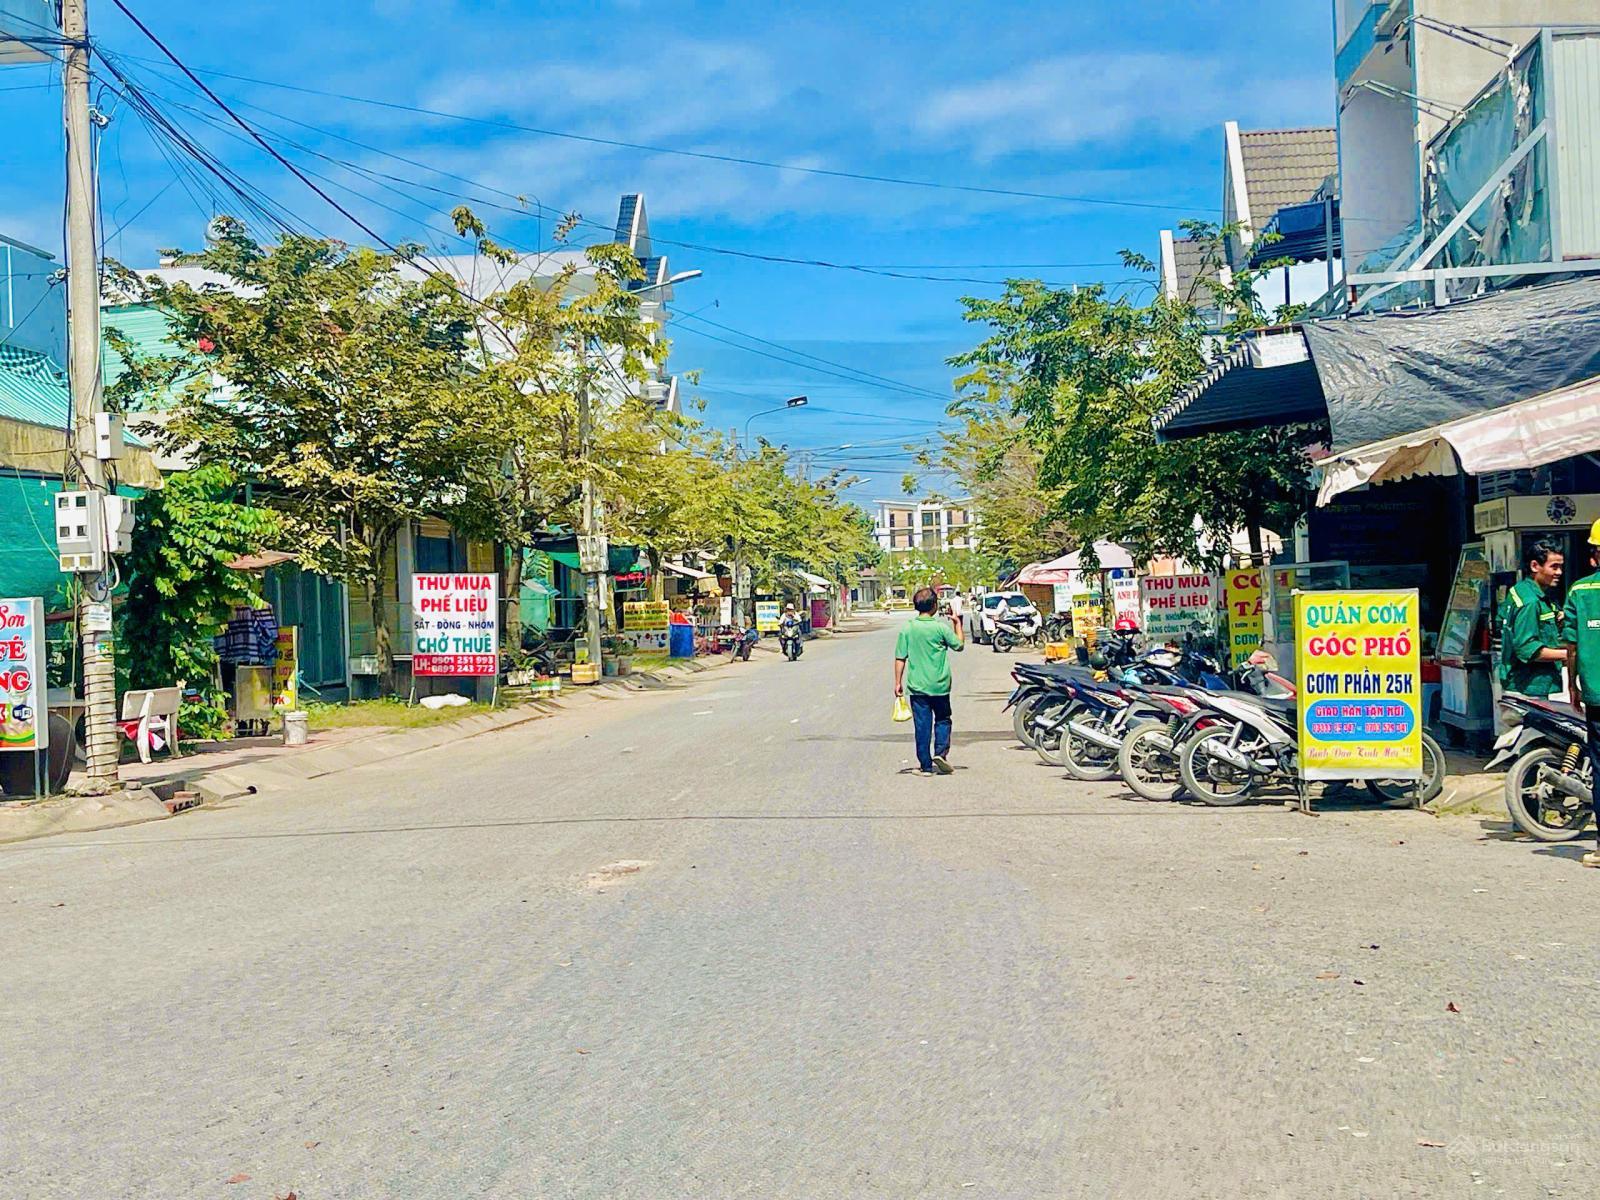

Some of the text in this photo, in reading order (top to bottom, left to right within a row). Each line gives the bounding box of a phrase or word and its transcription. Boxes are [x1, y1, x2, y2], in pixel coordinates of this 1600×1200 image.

[417, 576, 491, 590] THU MUA
[1145, 575, 1210, 590] THU MUA
[421, 593, 488, 616] PHẾ LIỆU
[1150, 592, 1176, 608] PHẾ
[1180, 592, 1208, 609] LIỆU
[1306, 600, 1408, 628] QUÁN CƠM
[453, 633, 492, 653] THUÊ
[1309, 628, 1411, 656] GÓC PHỐ
[476, 665, 495, 673] 772
[1306, 666, 1413, 694] CƠM PHẦN 25K
